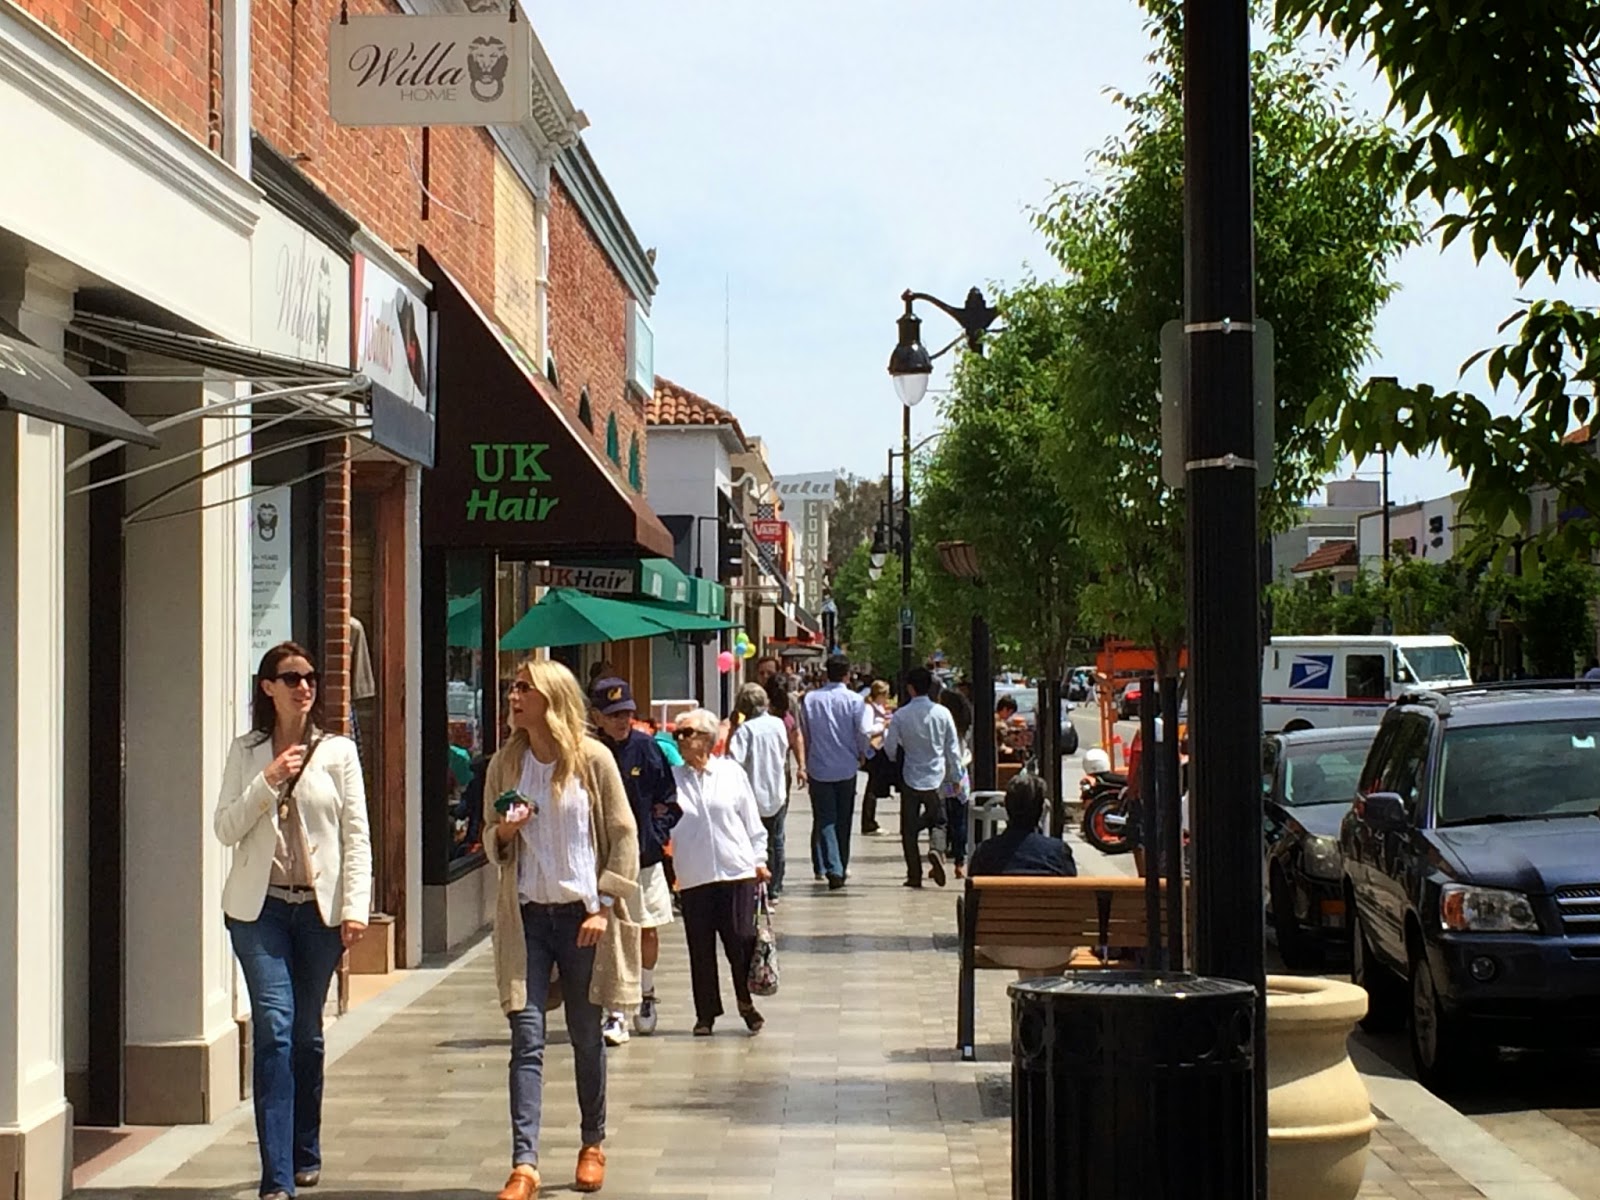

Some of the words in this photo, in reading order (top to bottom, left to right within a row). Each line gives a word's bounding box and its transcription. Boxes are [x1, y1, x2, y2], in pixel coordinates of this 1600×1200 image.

[349, 42, 465, 87] Willa
[401, 88, 457, 101] HOME
[470, 443, 552, 483] UK
[466, 487, 560, 521] Hair
